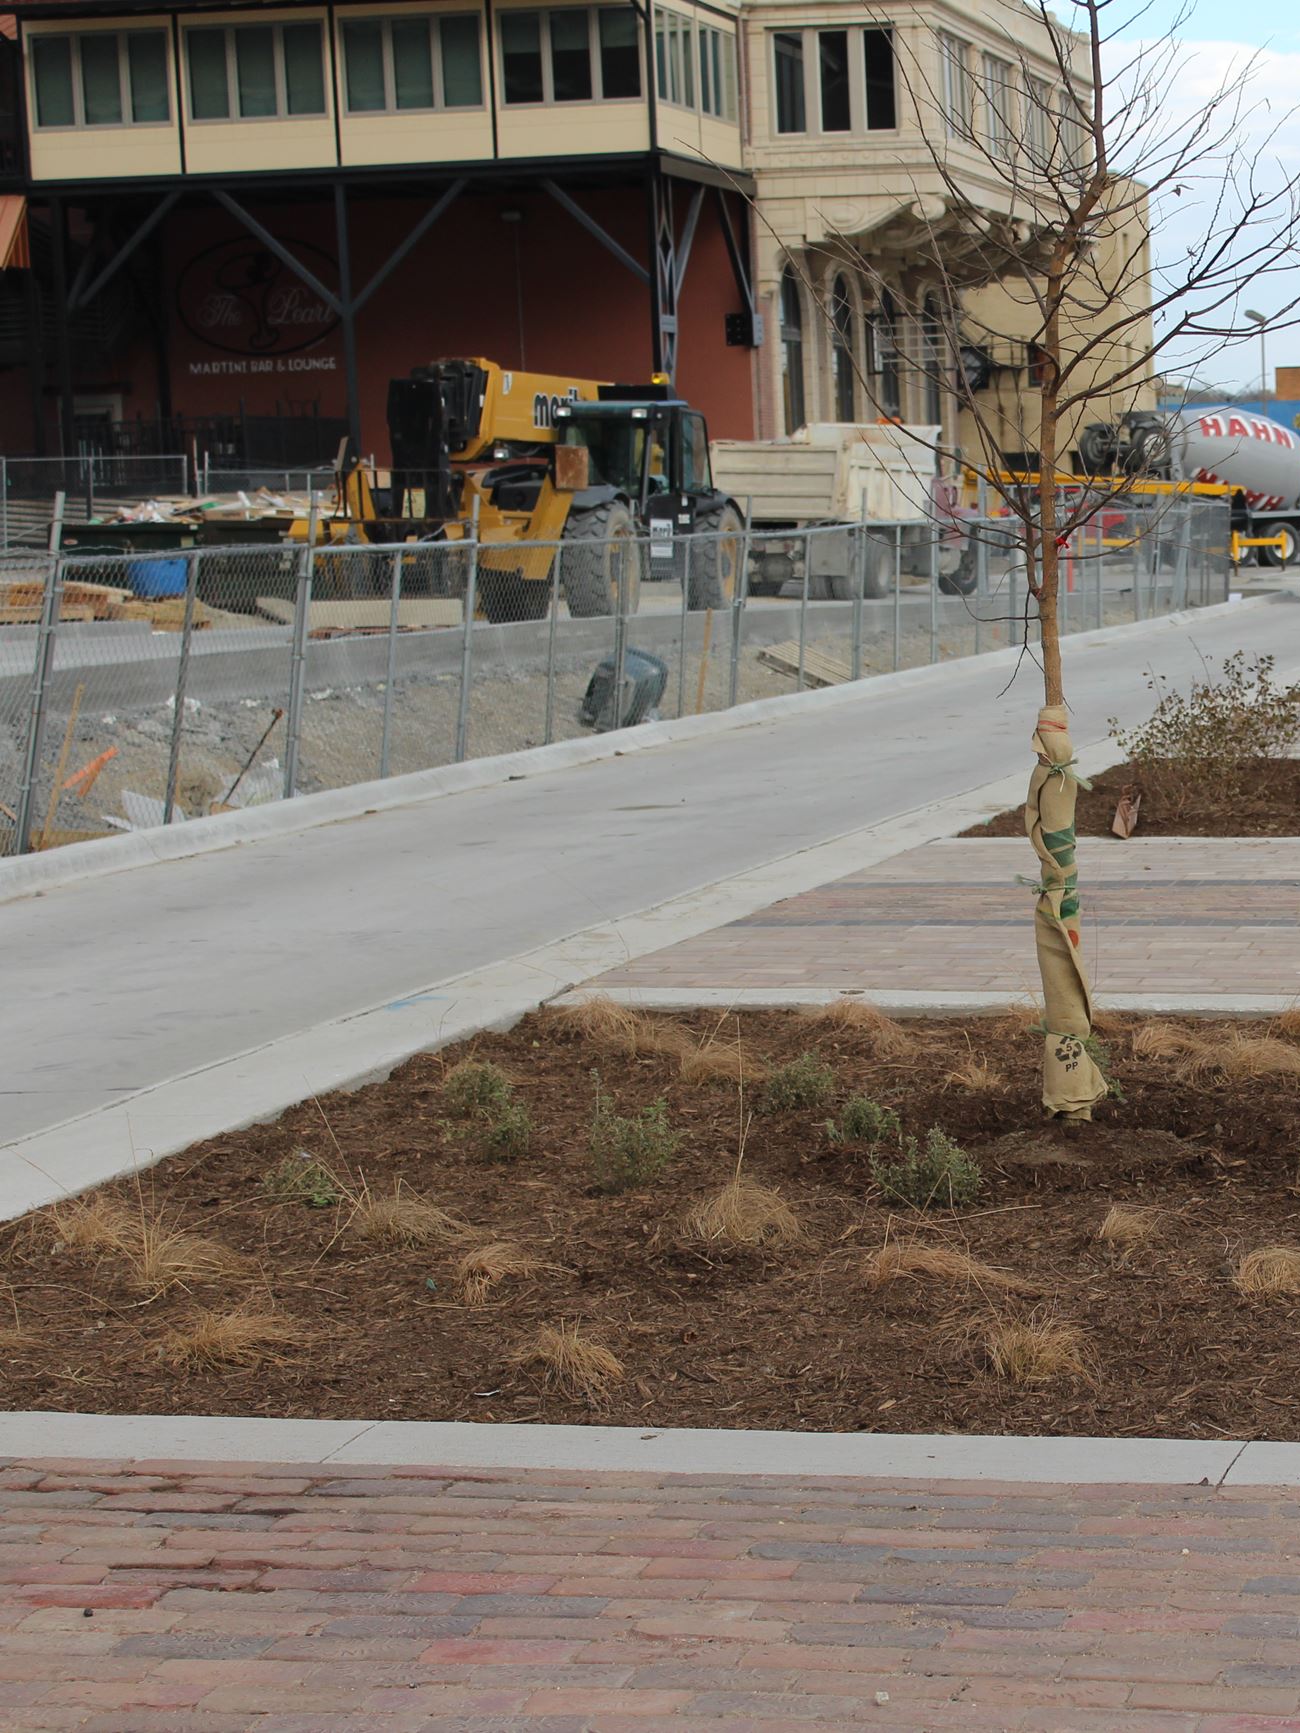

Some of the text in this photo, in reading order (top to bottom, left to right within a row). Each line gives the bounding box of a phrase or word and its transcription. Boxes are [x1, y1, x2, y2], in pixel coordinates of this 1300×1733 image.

[198, 294, 242, 328] The
[189, 357, 337, 375] MARTINI BAR & LOUNGE
[1198, 414, 1295, 449] HAHN
[1066, 1043, 1073, 1052] 5
[1065, 1061, 1078, 1072] PP
